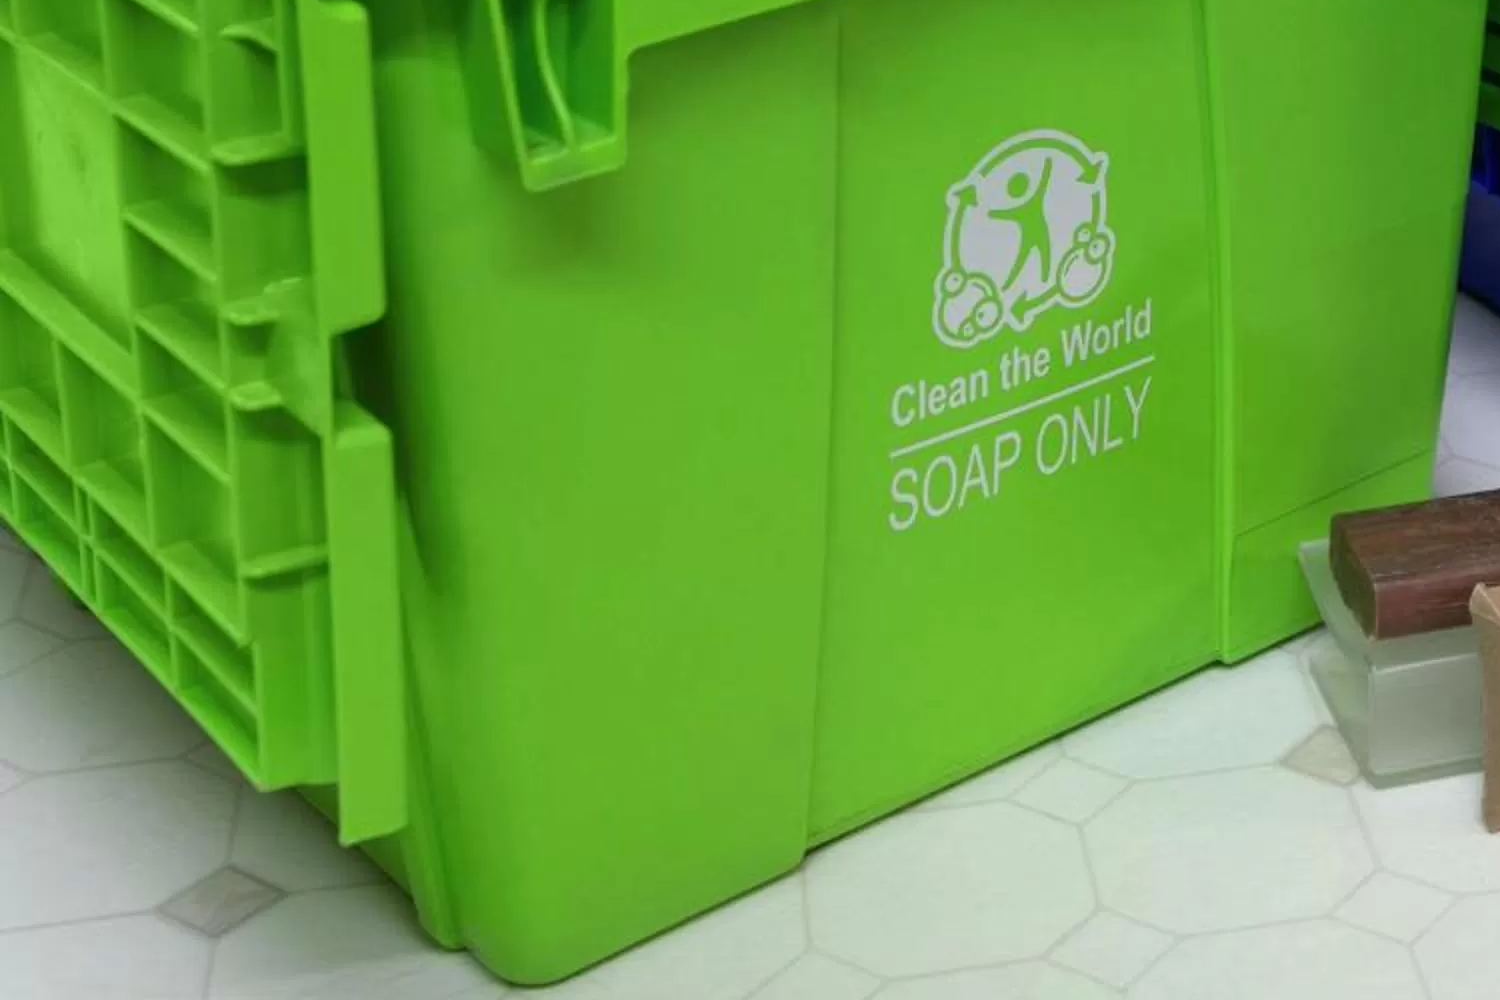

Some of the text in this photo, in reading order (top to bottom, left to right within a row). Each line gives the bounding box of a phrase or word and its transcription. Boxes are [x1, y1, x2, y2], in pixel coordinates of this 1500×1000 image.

[891, 298, 1152, 427] Clean the World
[889, 376, 1152, 531] SOAP ONLY
